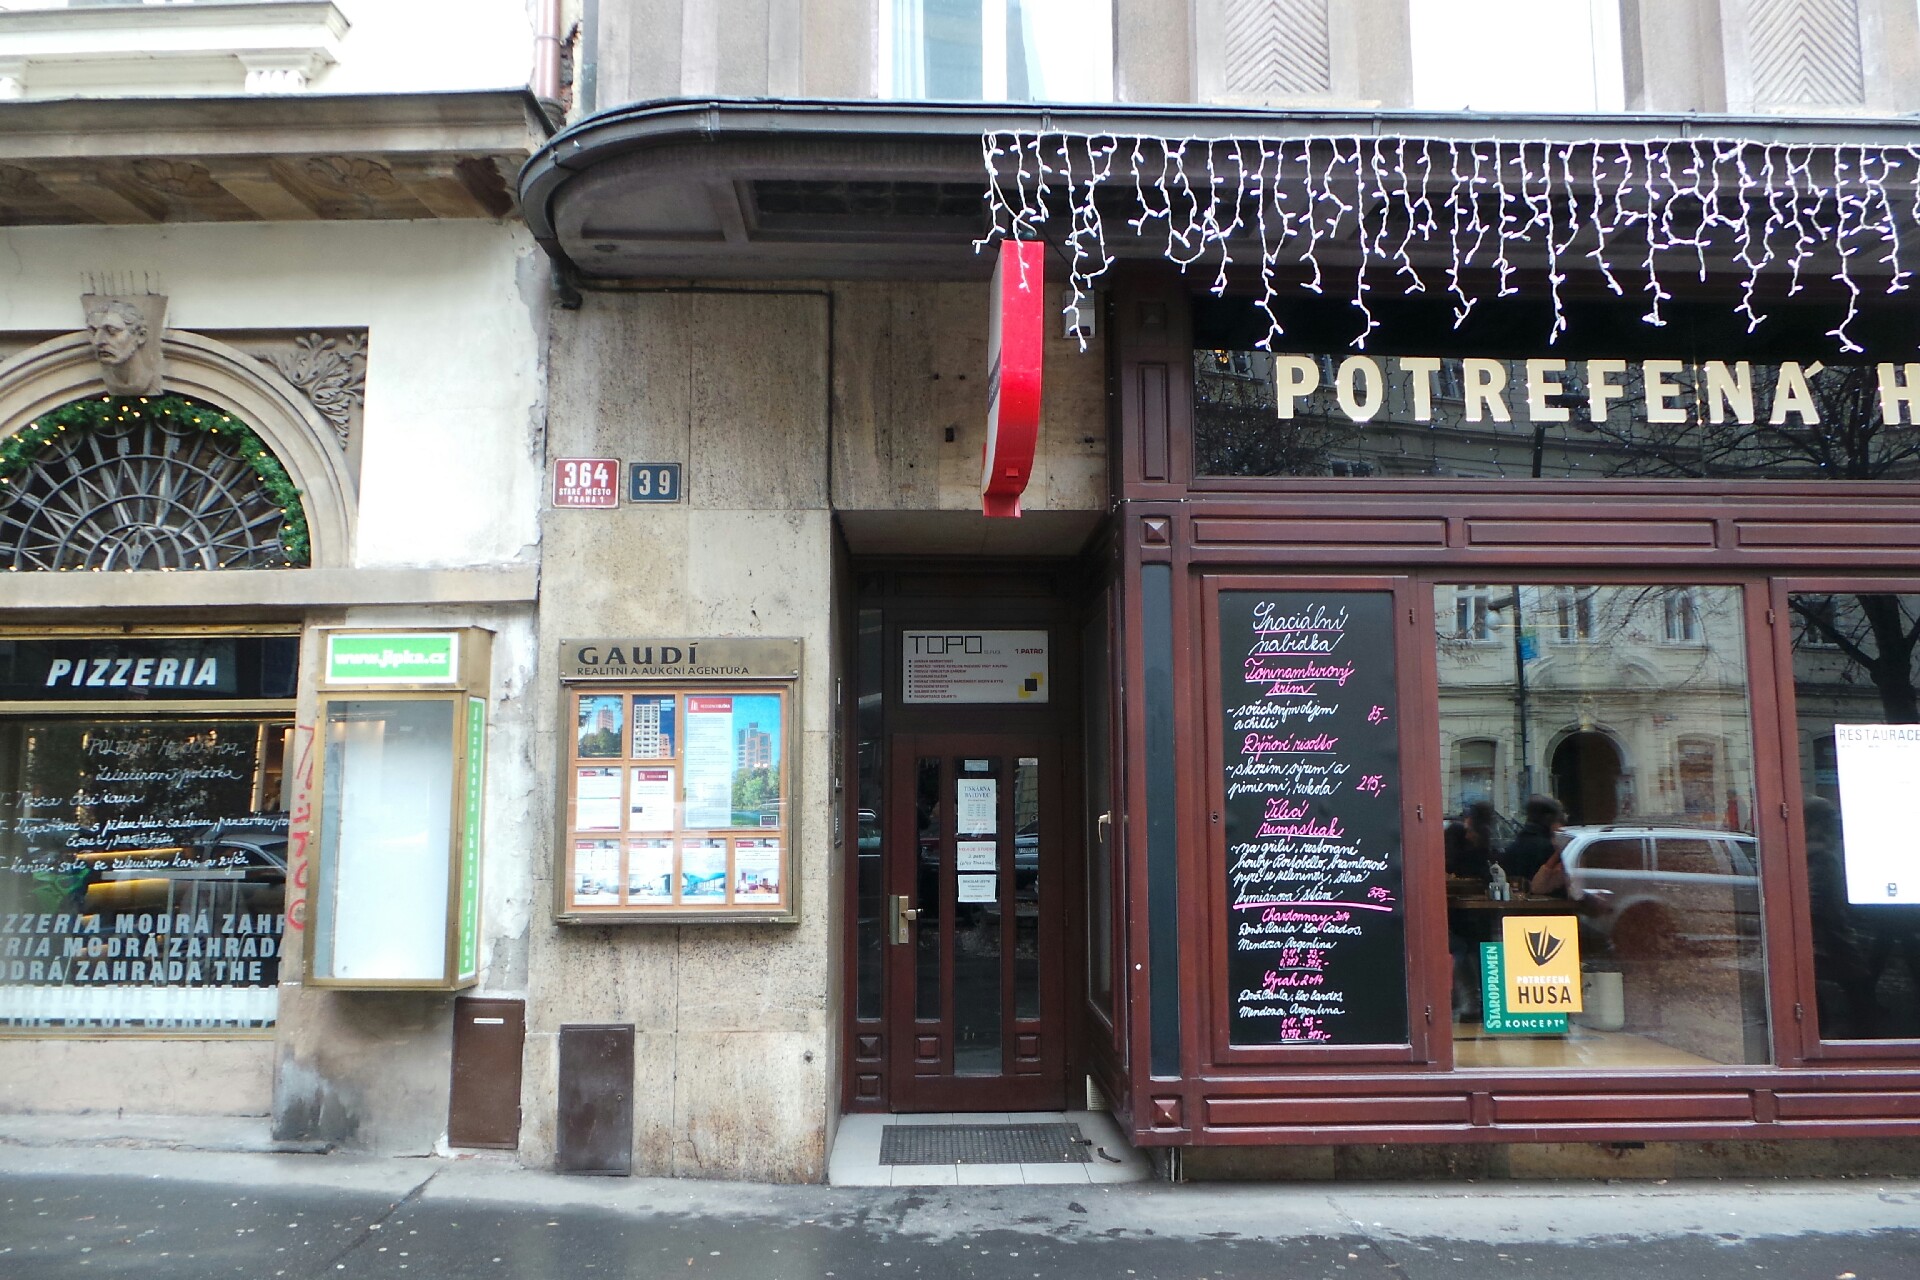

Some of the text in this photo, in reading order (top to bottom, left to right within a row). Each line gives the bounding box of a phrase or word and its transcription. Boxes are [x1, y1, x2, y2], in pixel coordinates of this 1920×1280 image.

[1275, 354, 1825, 426] POTREFENÁ
[564, 462, 609, 488] 364
[558, 487, 582, 496] STARÉ
[599, 496, 605, 504] 1
[577, 642, 699, 666] GAUDÍ
[908, 635, 982, 654] TOPO
[335, 649, 448, 668] www.jipka.cz
[45, 657, 218, 687] PIZZERIA
[577, 666, 628, 676] REALITNÍ
[631, 666, 638, 675] A
[688, 666, 750, 675] AGENTURA
[115, 909, 210, 934] MODRÁ
[63, 933, 159, 957] MODRÁ
[75, 961, 203, 981] ZAHRADA
[214, 961, 263, 981] THE
[1516, 975, 1571, 984] POTREFENÁ
[1518, 986, 1572, 1004] HUSA
